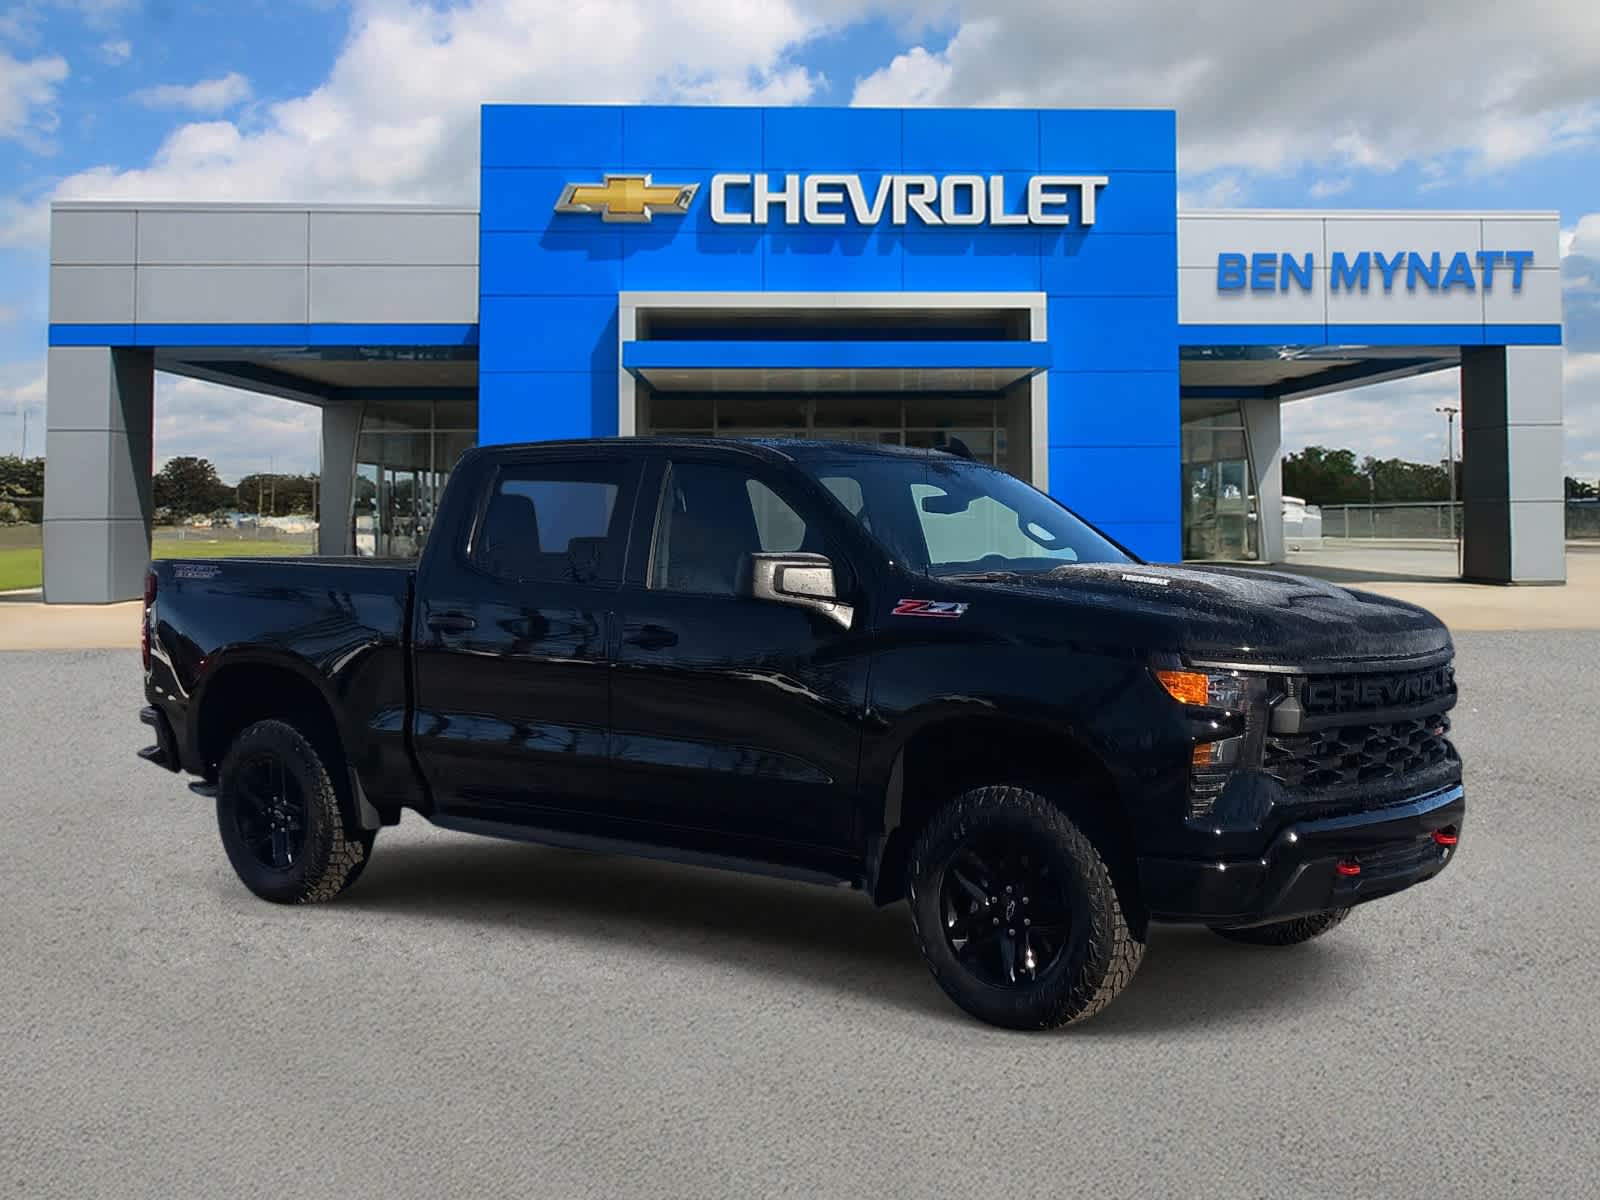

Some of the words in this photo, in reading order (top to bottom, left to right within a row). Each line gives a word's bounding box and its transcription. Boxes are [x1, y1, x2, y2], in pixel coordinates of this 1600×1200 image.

[711, 174, 1108, 225] CHEVROLET
[1217, 252, 1313, 290] BEN
[1330, 250, 1534, 290] MYNATT
[1308, 669, 1455, 705] CHEVROL
